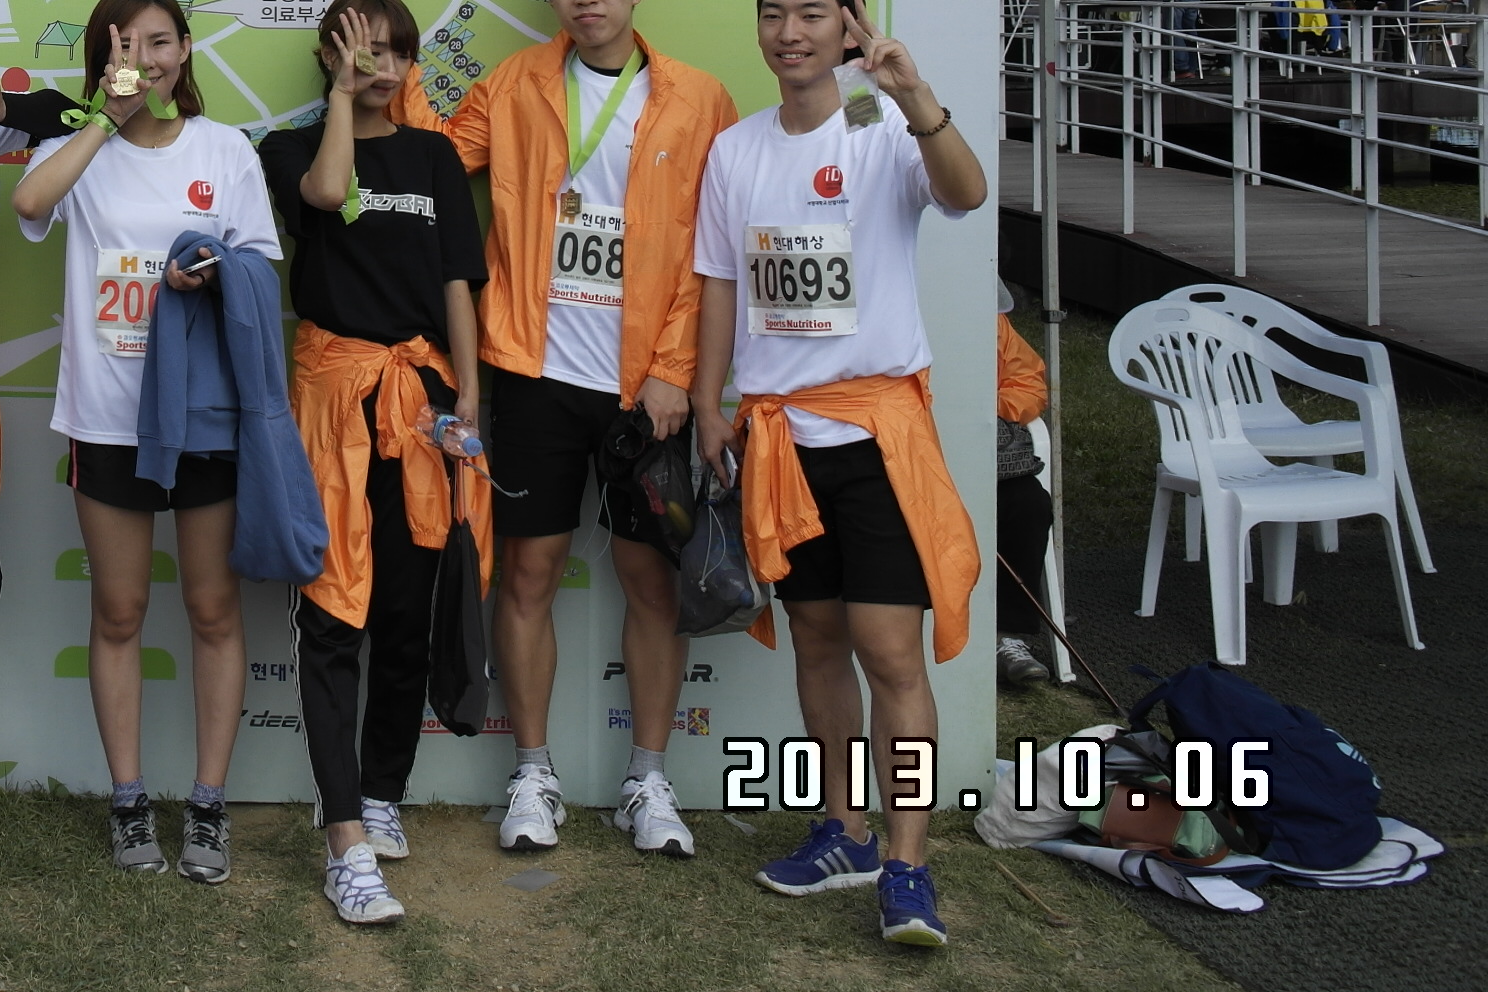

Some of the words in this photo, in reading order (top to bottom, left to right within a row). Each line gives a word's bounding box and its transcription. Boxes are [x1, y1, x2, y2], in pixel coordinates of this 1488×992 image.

[462, 7, 472, 16] 31
[437, 32, 448, 40] 27
[451, 41, 462, 49] 28
[455, 58, 466, 66] 29
[468, 66, 479, 75] 30
[437, 78, 448, 87] 17
[448, 90, 460, 98] 20
[582, 213, 626, 231] 현대해
[773, 235, 824, 250] 현대해상
[557, 231, 624, 280] 068
[750, 257, 852, 302] 10693
[549, 288, 579, 298] Sports
[765, 319, 786, 329] Sports
[786, 319, 832, 329] Nutrition
